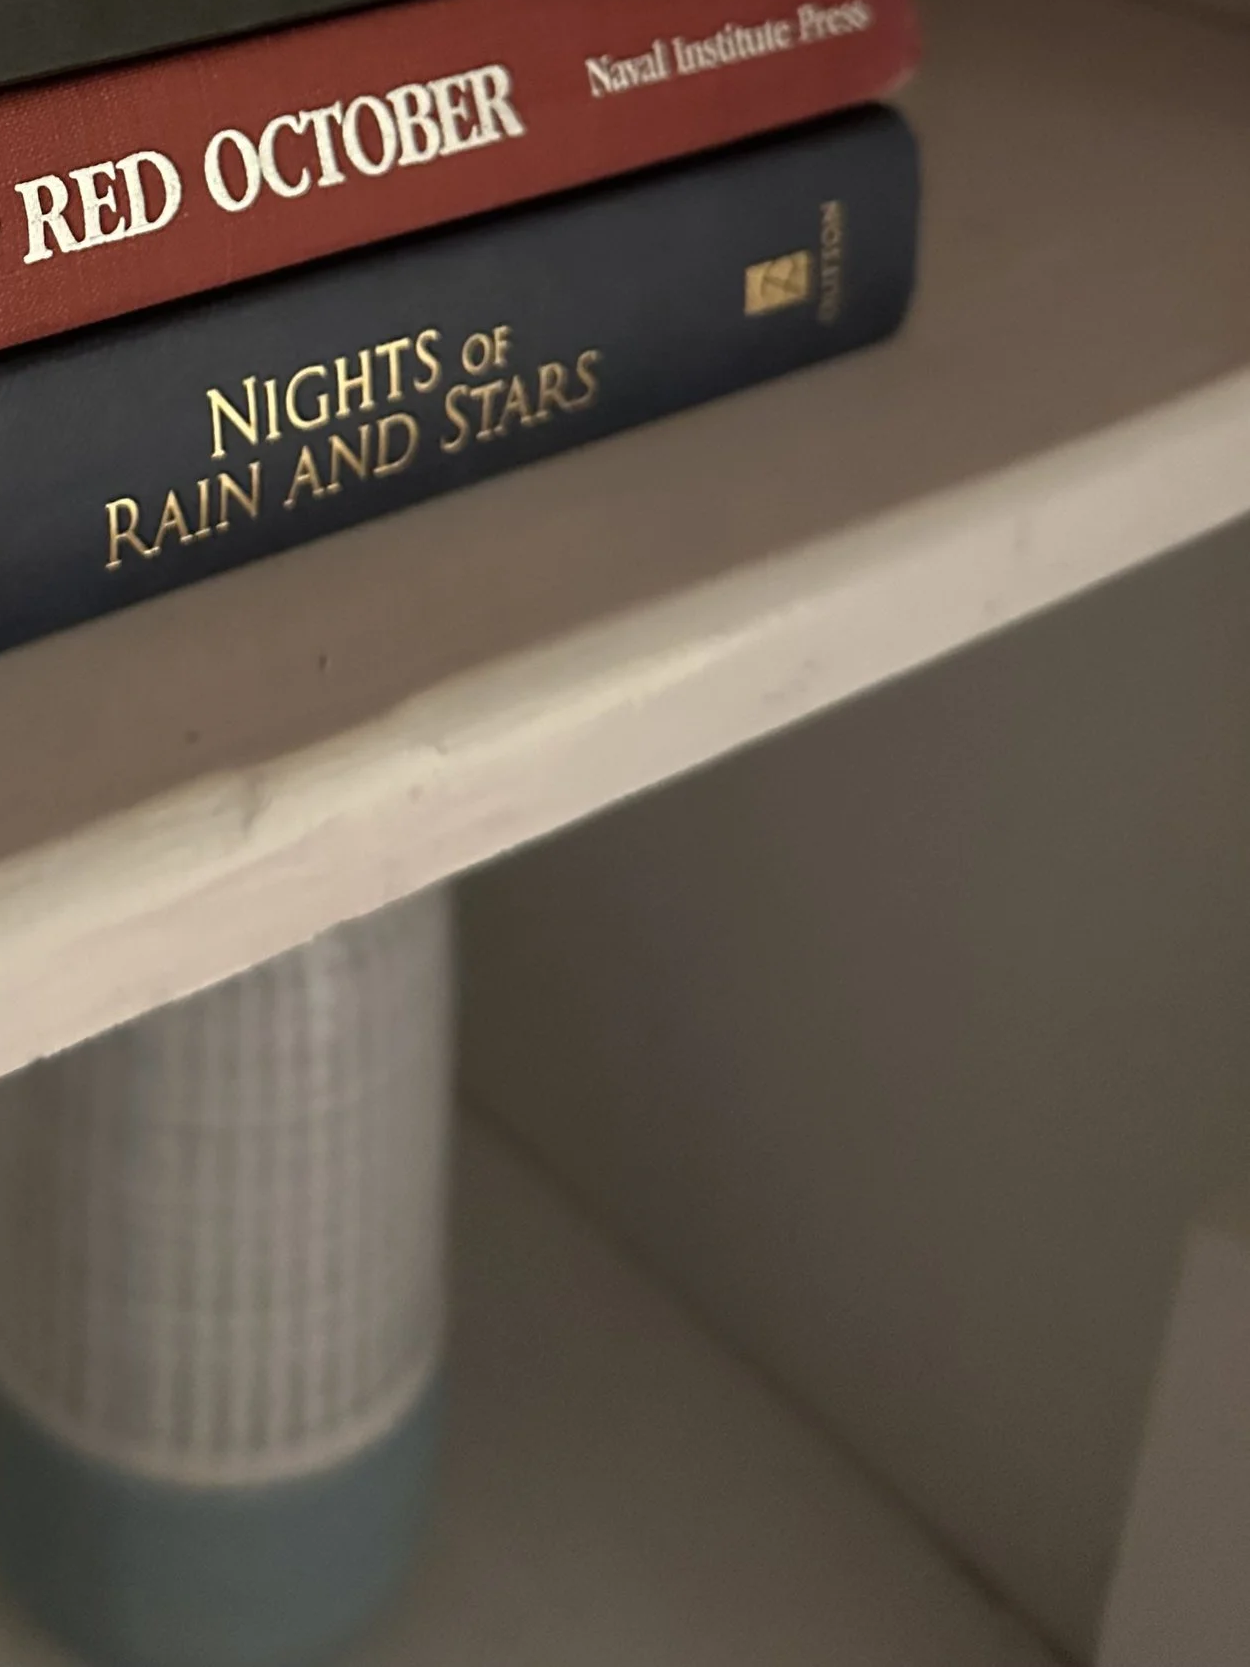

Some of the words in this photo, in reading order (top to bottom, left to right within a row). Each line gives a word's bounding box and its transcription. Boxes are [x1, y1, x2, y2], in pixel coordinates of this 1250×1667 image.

[584, 38, 670, 98] Naval
[673, 18, 792, 75] Institute
[797, 0, 869, 40] Press
[14, 150, 182, 264] RED
[204, 64, 527, 212] OCTOBER
[104, 461, 264, 570] RAIN
[284, 413, 420, 509] AND
[440, 350, 602, 452] STARS
[205, 329, 444, 459] NIGHTS
[462, 325, 512, 375] OF
